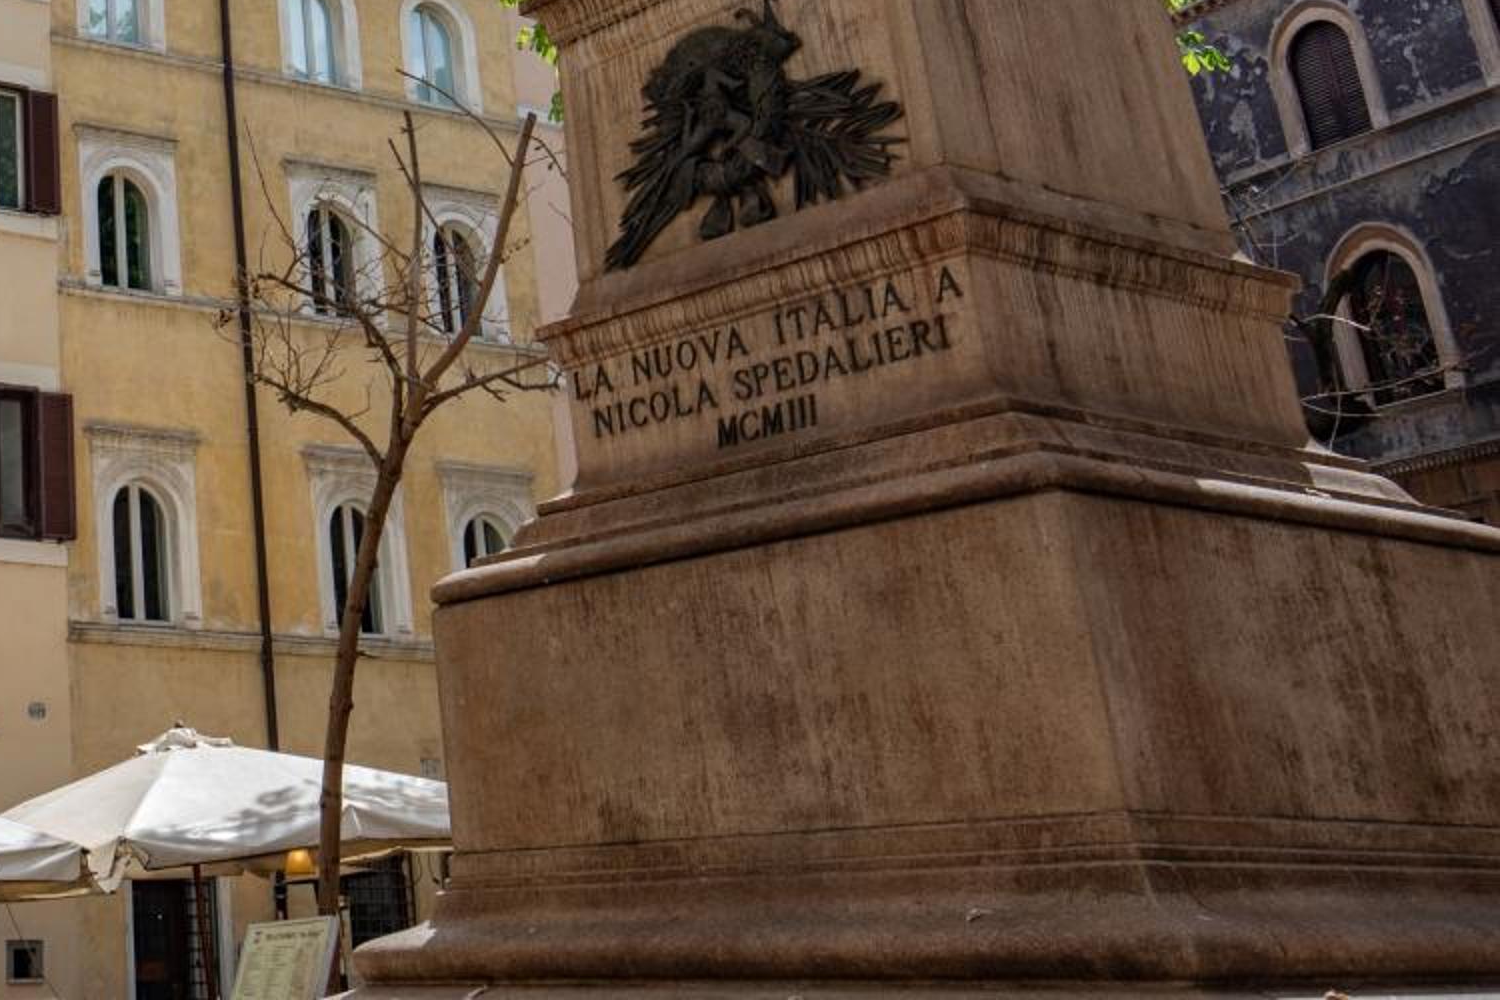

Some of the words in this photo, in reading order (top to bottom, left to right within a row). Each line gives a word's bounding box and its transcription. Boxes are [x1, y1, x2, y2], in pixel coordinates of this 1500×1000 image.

[573, 365, 613, 401] LA
[631, 325, 750, 386] NUOVA
[773, 280, 911, 345] ITALIA
[936, 265, 964, 303] A
[594, 380, 719, 438] NICOLA
[733, 313, 953, 400] SPEDALIERI
[716, 393, 818, 449] MCMIII
